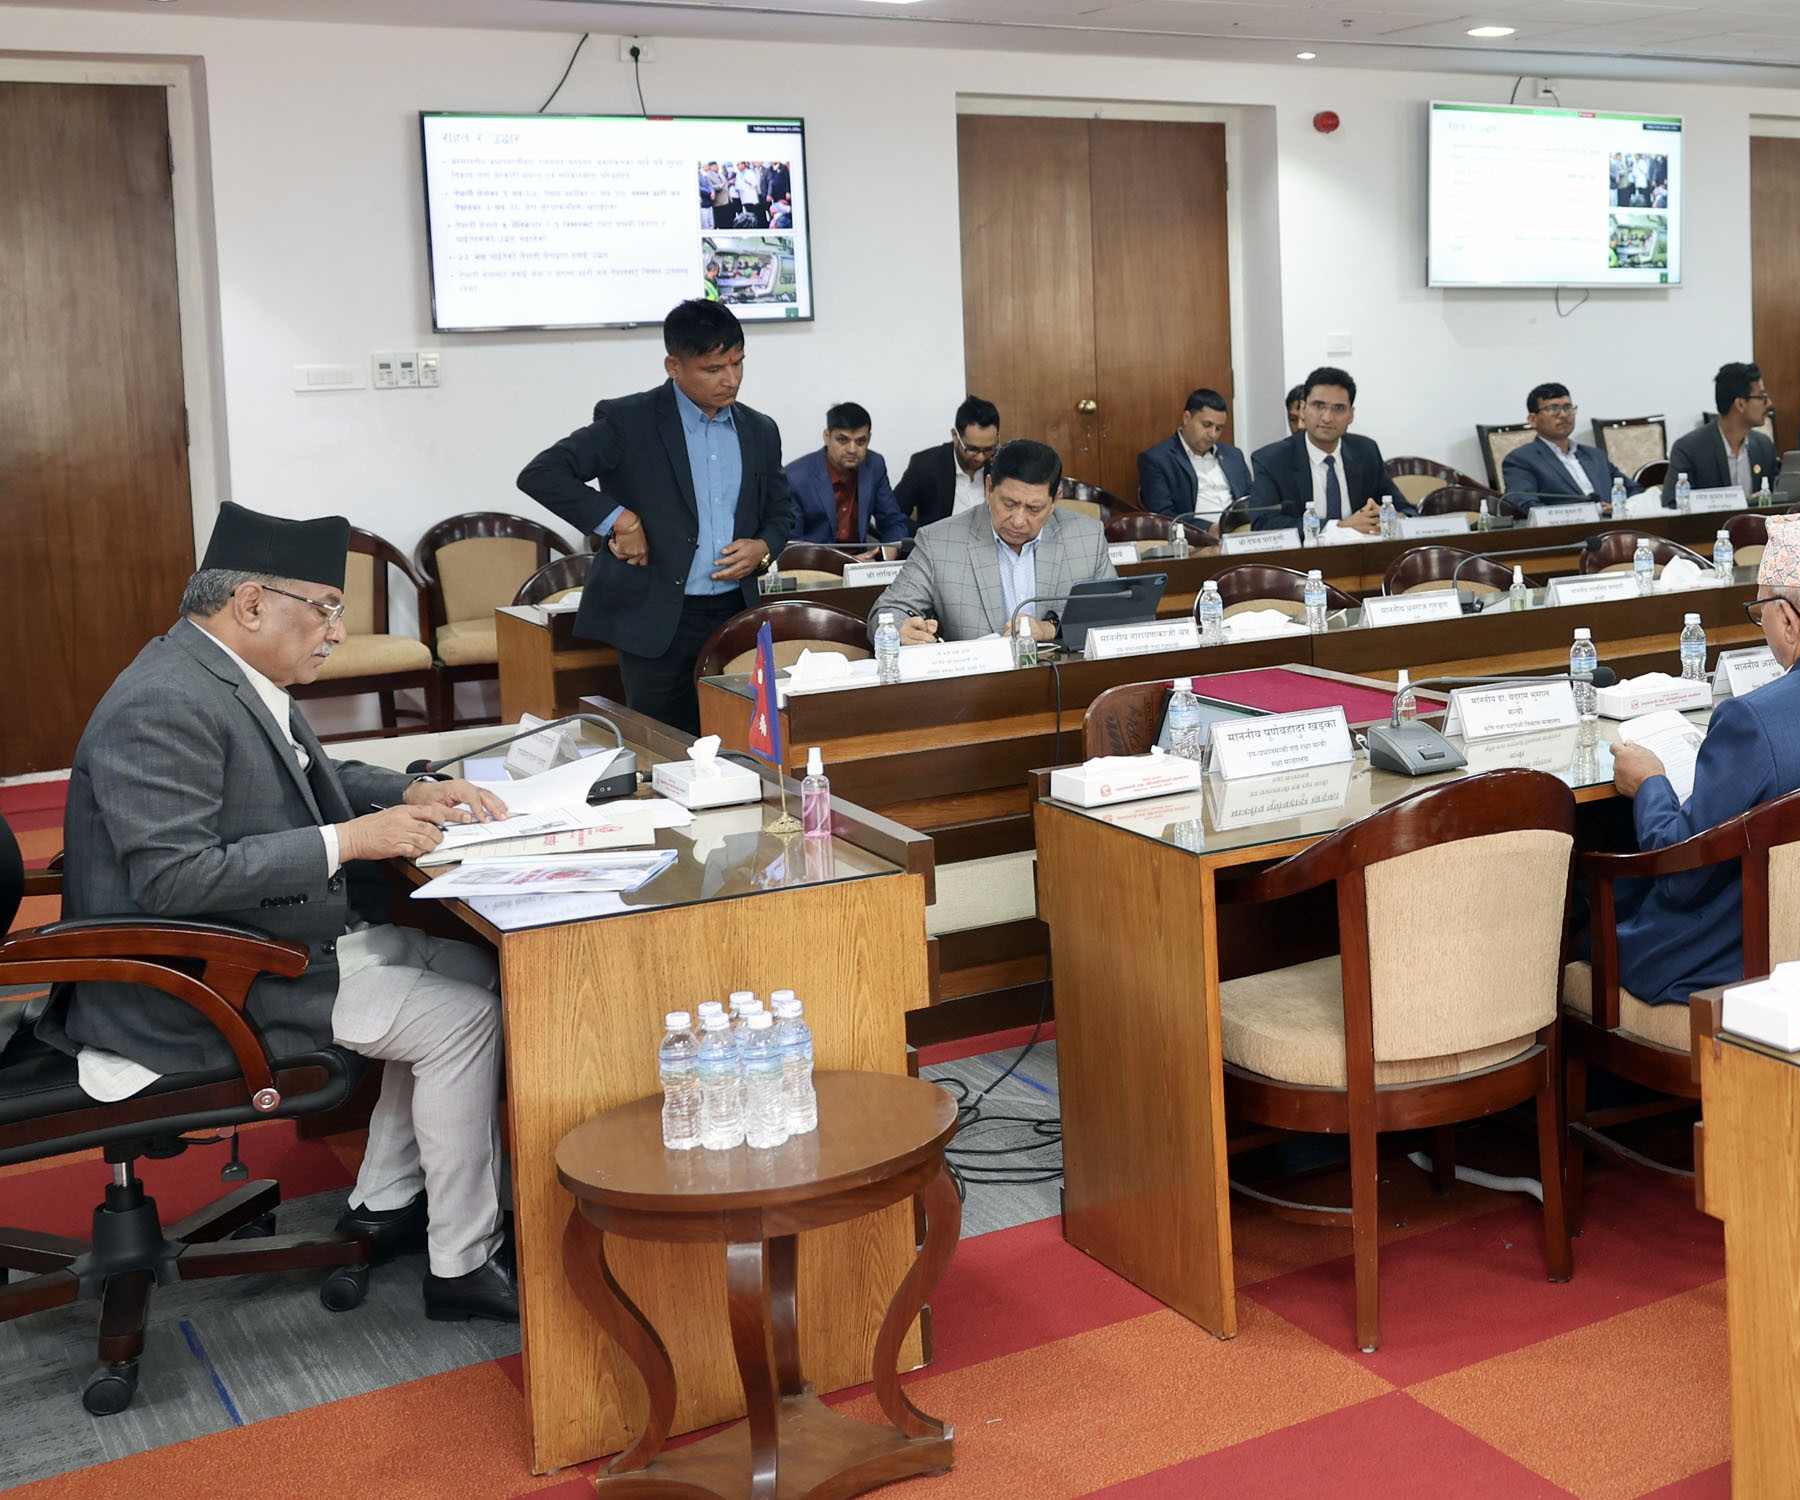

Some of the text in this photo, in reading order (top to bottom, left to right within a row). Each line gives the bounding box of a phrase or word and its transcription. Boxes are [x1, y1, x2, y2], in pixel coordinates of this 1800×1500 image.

[1100, 631, 1128, 642] माननीय
[1734, 656, 1777, 671] माननीय अशो
[1470, 694, 1496, 705] माननीय
[1507, 706, 1523, 716] मन्त्री
[1227, 728, 1261, 742] माननीय
[1307, 719, 1336, 731] खड्का
